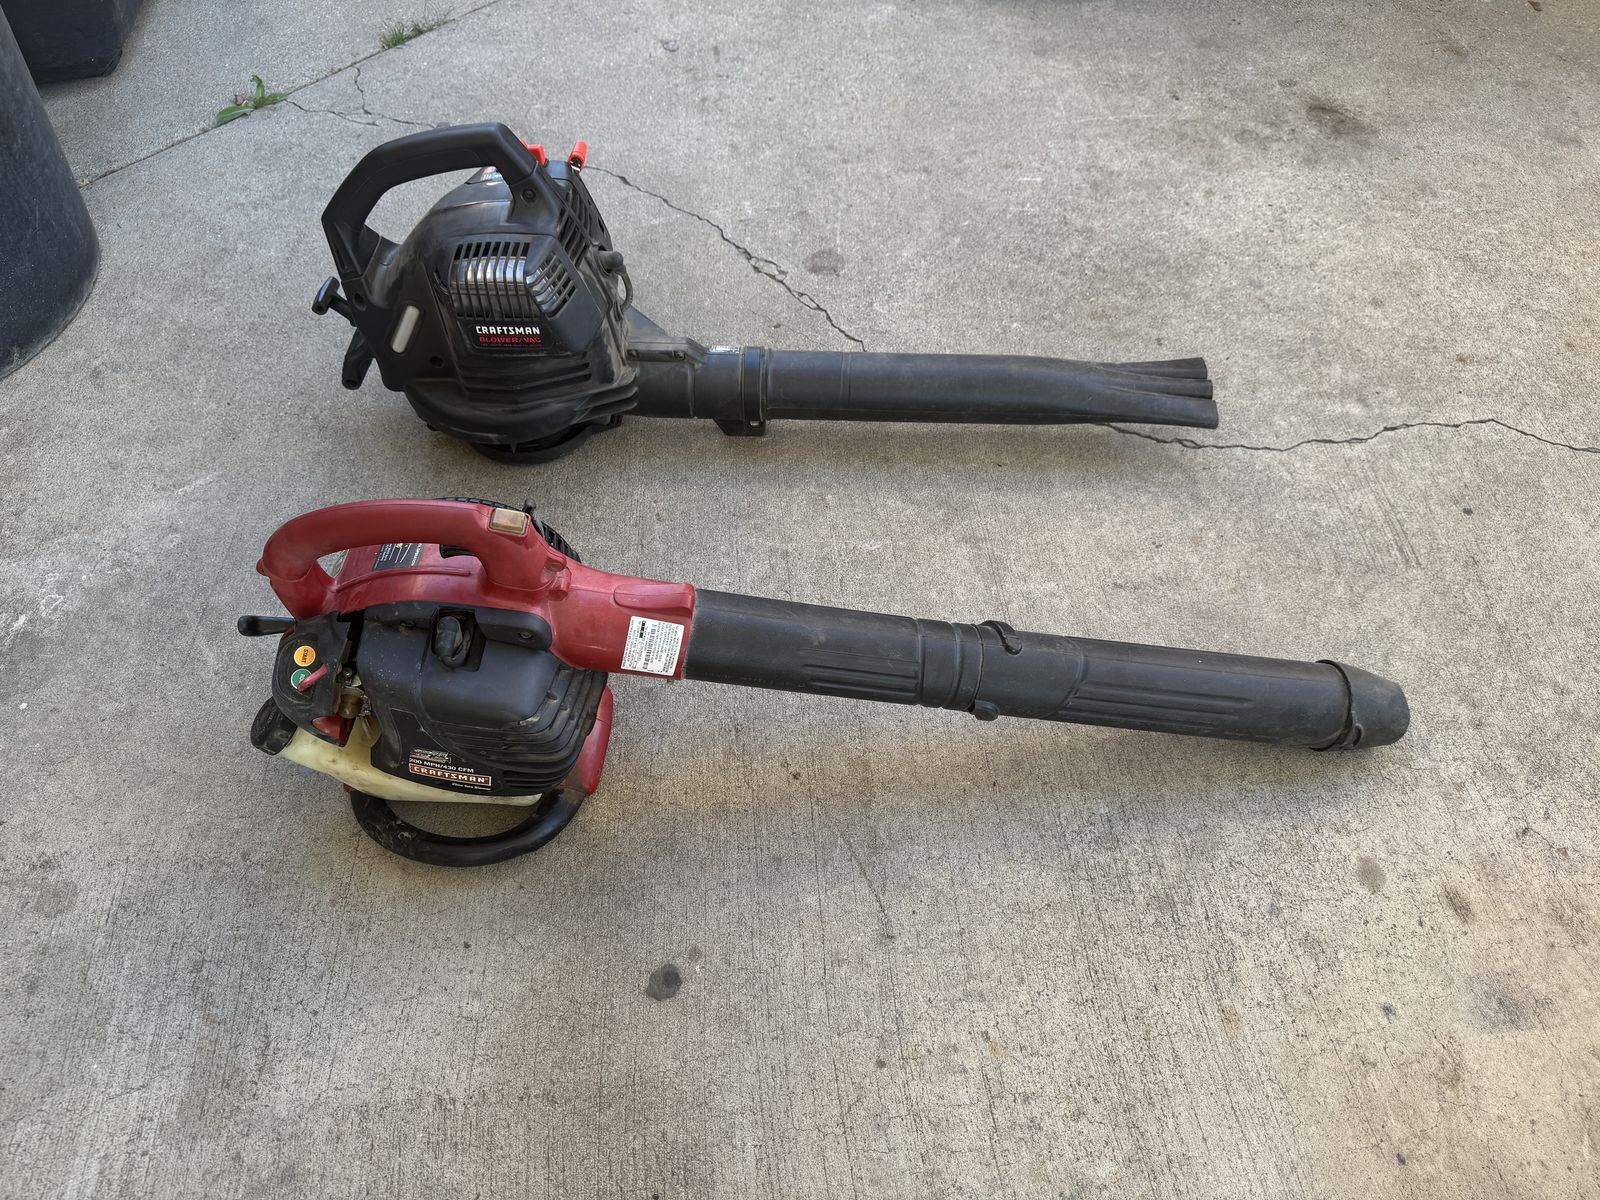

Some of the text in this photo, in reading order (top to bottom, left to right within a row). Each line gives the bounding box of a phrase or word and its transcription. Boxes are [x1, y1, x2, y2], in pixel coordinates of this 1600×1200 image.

[475, 325, 541, 335] CRAFTSMAN
[423, 761, 456, 771] MPH/430
[413, 766, 485, 783] CRAFTSMAN
